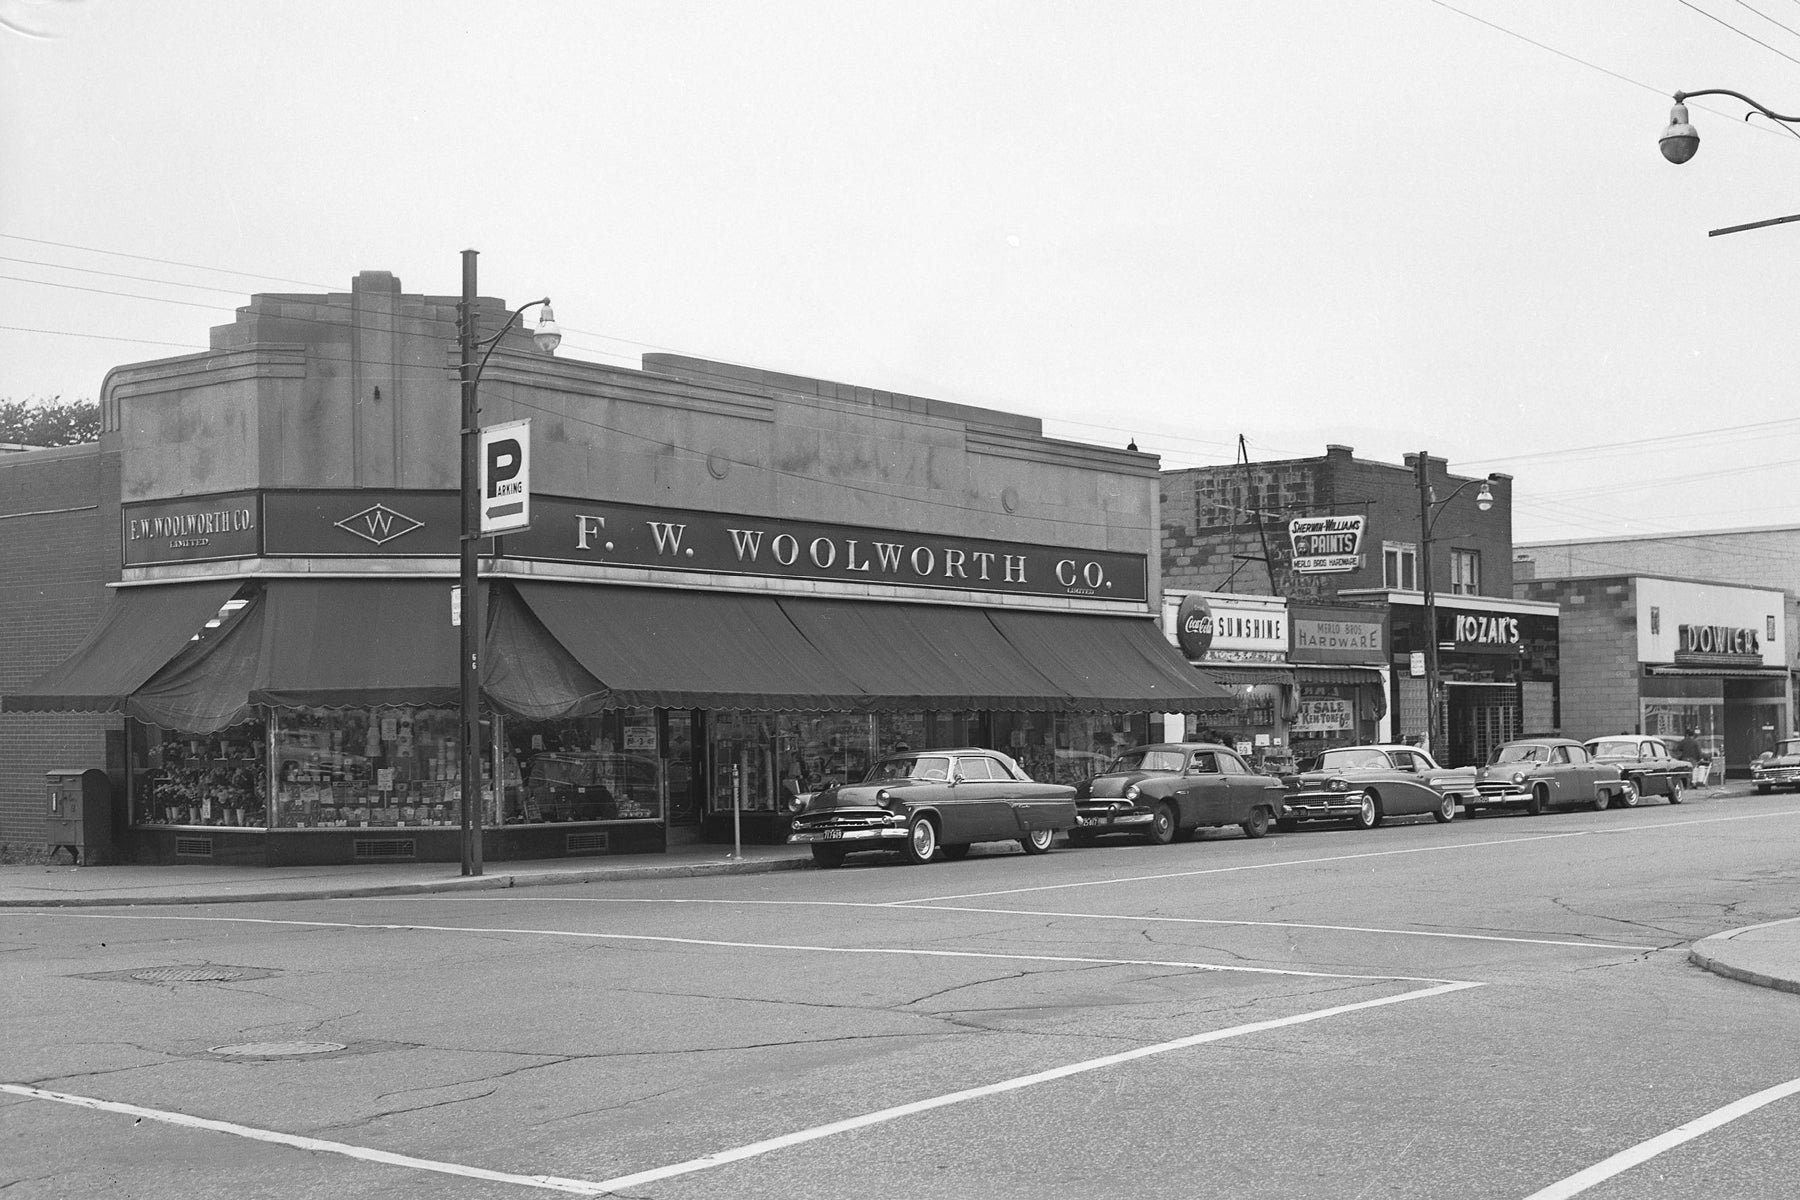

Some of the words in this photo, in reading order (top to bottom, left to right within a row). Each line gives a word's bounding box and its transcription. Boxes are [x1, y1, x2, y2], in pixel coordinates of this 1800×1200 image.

[154, 511, 230, 537] WOOLWORTH
[233, 509, 255, 531] CO.
[364, 510, 394, 536] W
[1292, 519, 1361, 533] SHERWIN-WILLIAMS
[575, 514, 614, 552] F.
[646, 521, 694, 558] W.
[727, 528, 1028, 583] WOOLWORTH
[1055, 559, 1112, 589] CO.
[1311, 533, 1353, 554] PAINTS
[1294, 560, 1310, 568] MERLO
[1329, 557, 1357, 566] HARDWARE
[1218, 617, 1281, 639] SUNSHINE
[1298, 628, 1378, 648] HARDWARE
[1317, 622, 1340, 634] MERLO
[1456, 614, 1520, 644] KOZAK'S
[1314, 702, 1345, 713] SALE
